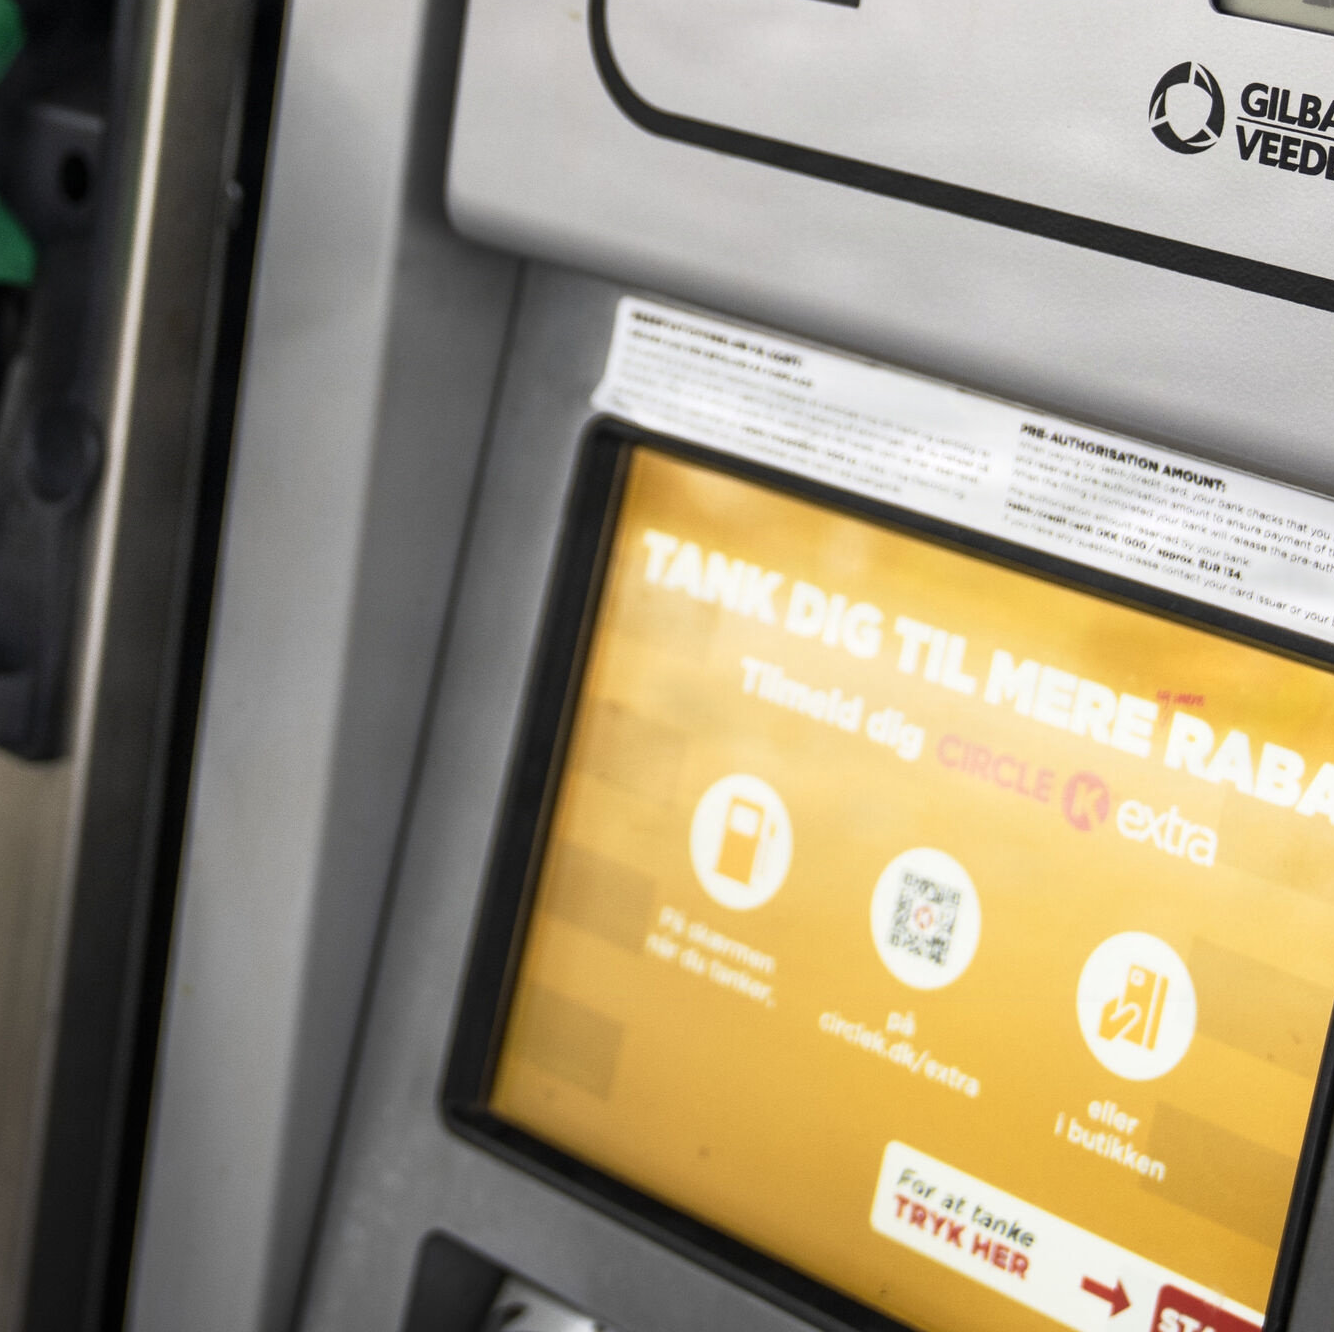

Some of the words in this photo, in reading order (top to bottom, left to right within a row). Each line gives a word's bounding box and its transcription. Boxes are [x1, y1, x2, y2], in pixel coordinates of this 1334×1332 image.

[1161, 464, 1227, 494] AMOUNT:
[1263, 527, 1311, 552] payment
[1285, 518, 1307, 533] that
[1309, 528, 1330, 542] you
[1269, 545, 1288, 559] the
[1304, 607, 1329, 624] your
[642, 527, 785, 627] TANK
[784, 579, 886, 660] DIG
[894, 615, 977, 696] TIL
[983, 648, 1159, 759] MERE
[740, 655, 866, 733] Tilmeld
[866, 707, 926, 762] dig
[936, 733, 1056, 805] CIRCLE
[1115, 798, 1219, 868] extra
[885, 1010, 916, 1037] på
[1087, 1099, 1140, 1136] eller
[1067, 1117, 1167, 1183] butikken
[896, 1167, 937, 1199] For
[941, 1192, 967, 1215] at
[971, 1203, 1035, 1248] tanke
[894, 1194, 965, 1250] TRYK
[971, 1233, 1031, 1280] HER
[1158, 1307, 1218, 1332] ST
